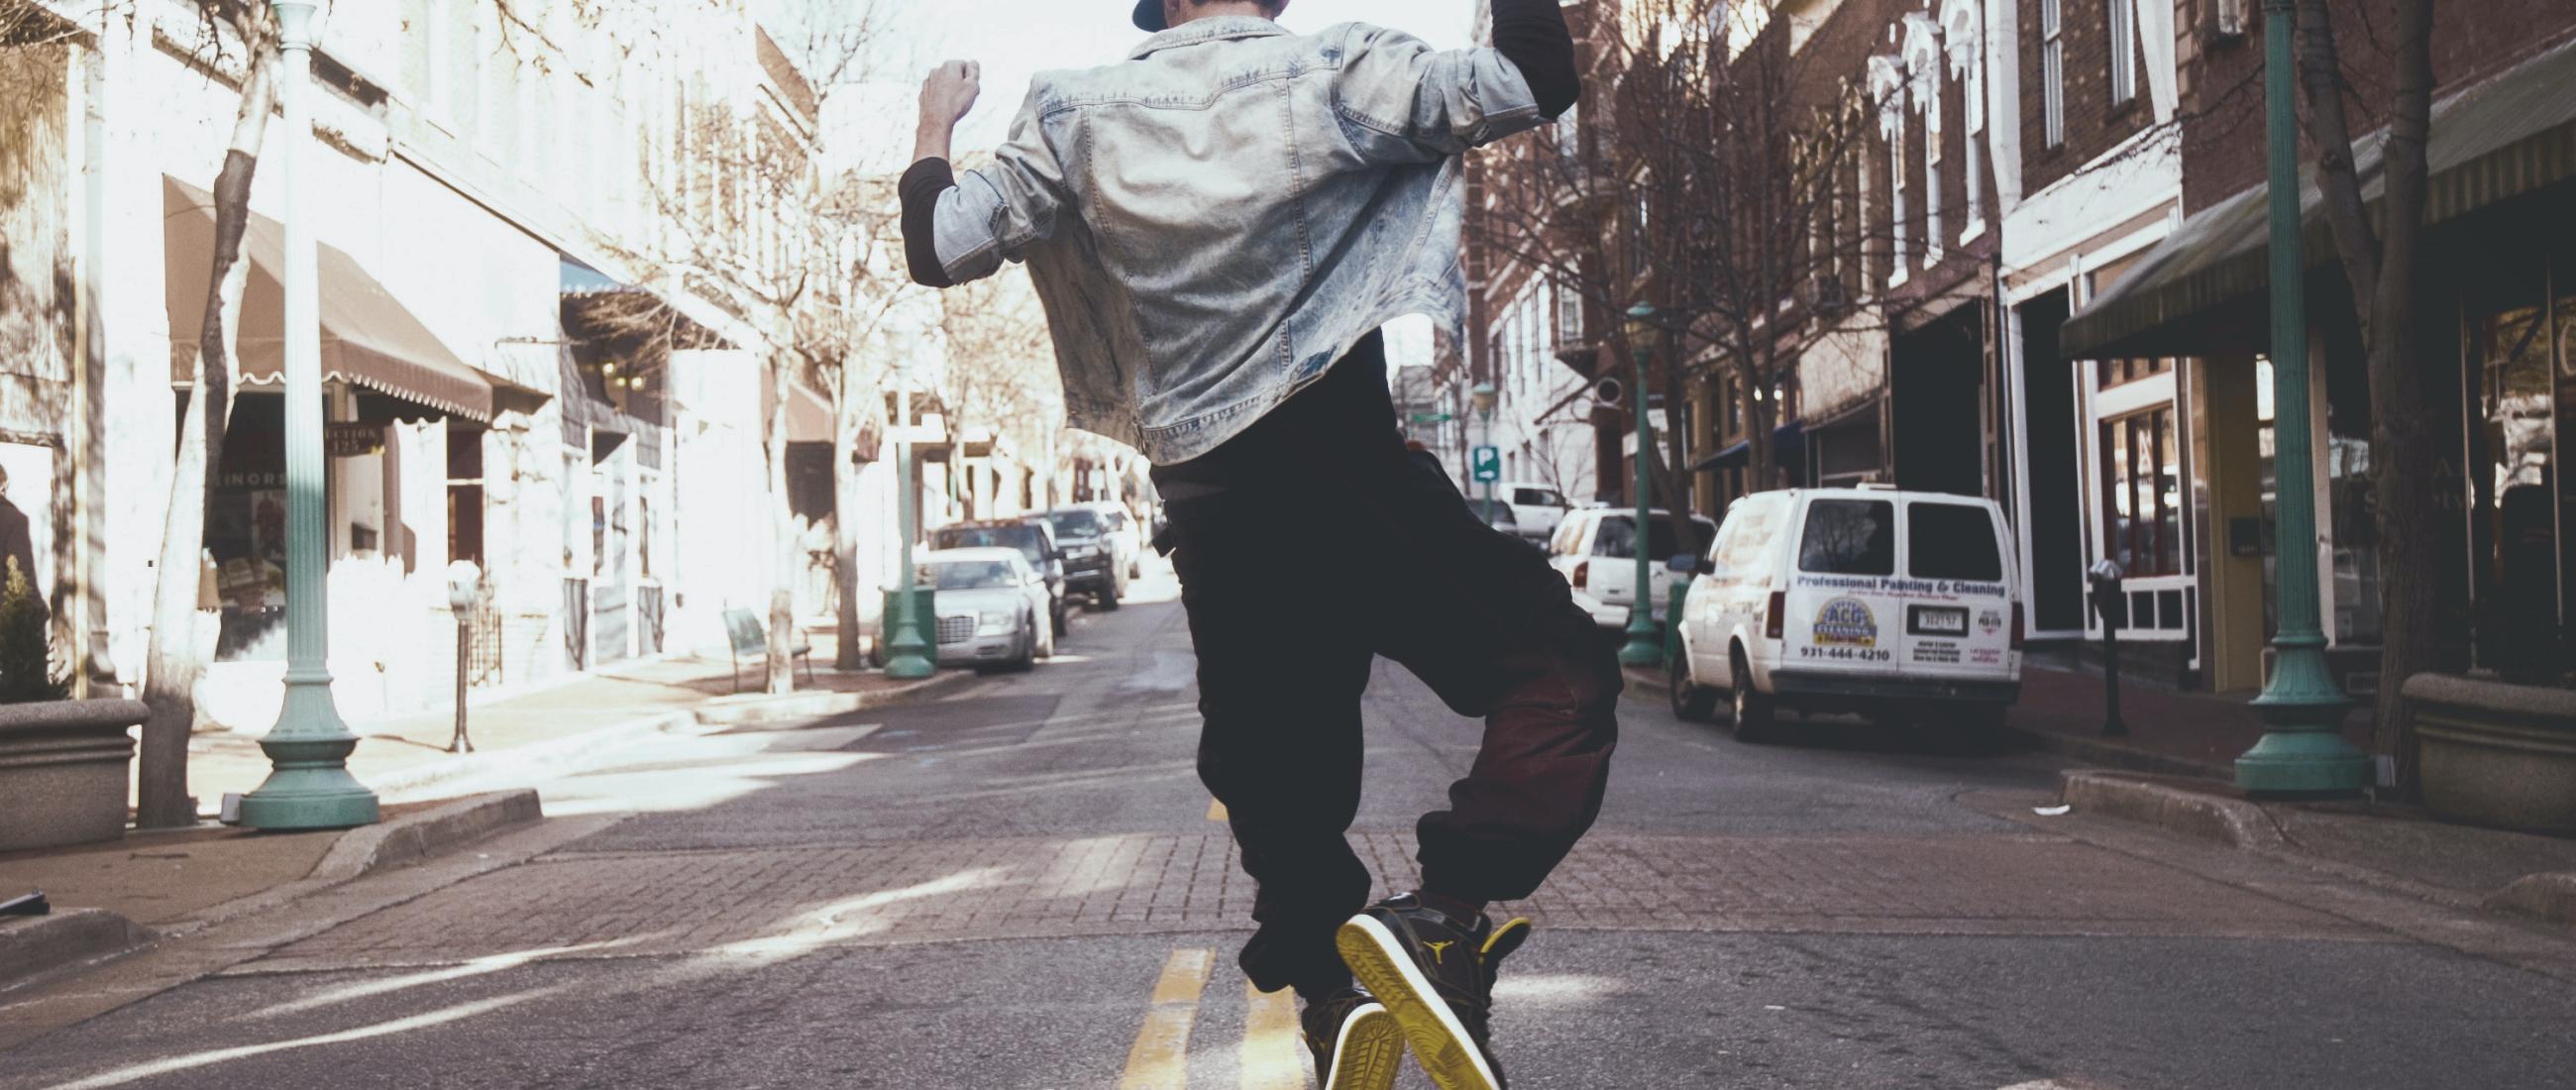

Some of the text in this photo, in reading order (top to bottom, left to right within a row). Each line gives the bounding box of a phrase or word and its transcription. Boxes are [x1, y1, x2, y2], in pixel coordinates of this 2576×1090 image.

[1477, 448, 1494, 467] P
[1797, 576, 1877, 589] Professional
[1880, 579, 1933, 594] Painting
[1936, 581, 1949, 594] &
[1953, 582, 2005, 599] Cleaning
[1800, 647, 1890, 661] 931-444-4210
